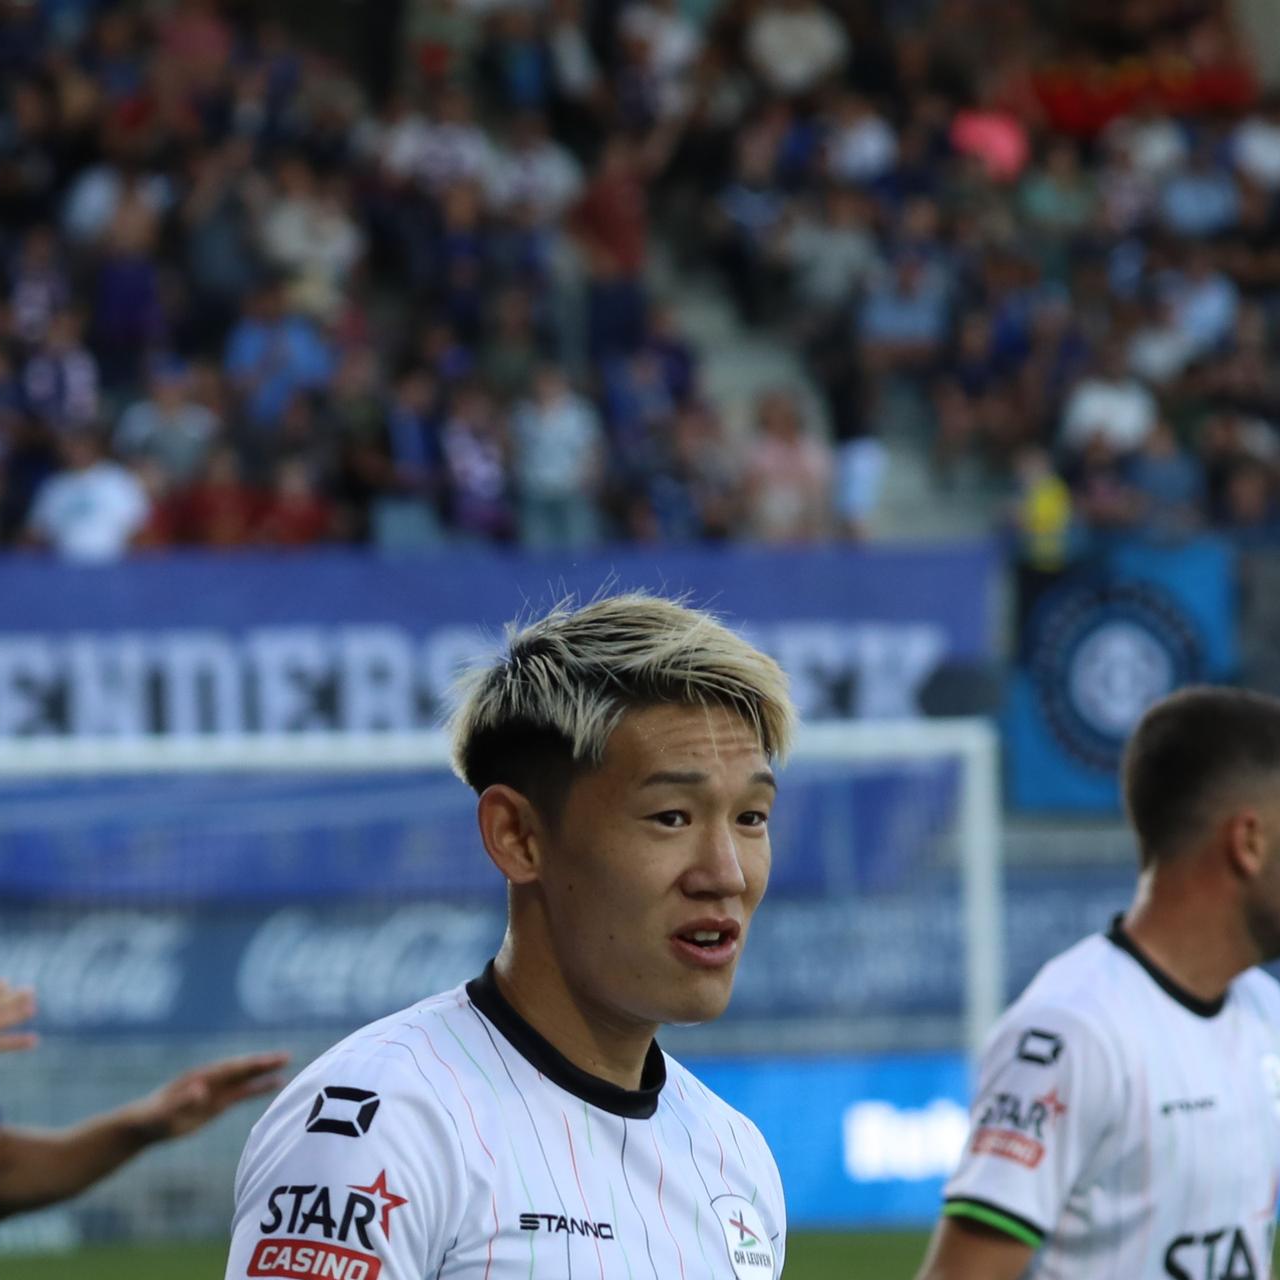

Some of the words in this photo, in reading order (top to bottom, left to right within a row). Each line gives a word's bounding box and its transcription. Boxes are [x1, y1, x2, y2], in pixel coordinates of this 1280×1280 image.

[260, 1184, 376, 1251] STAR
[520, 1213, 614, 1240] STANNO
[734, 1250, 746, 1265] OH
[747, 1250, 773, 1268] LEUVEN
